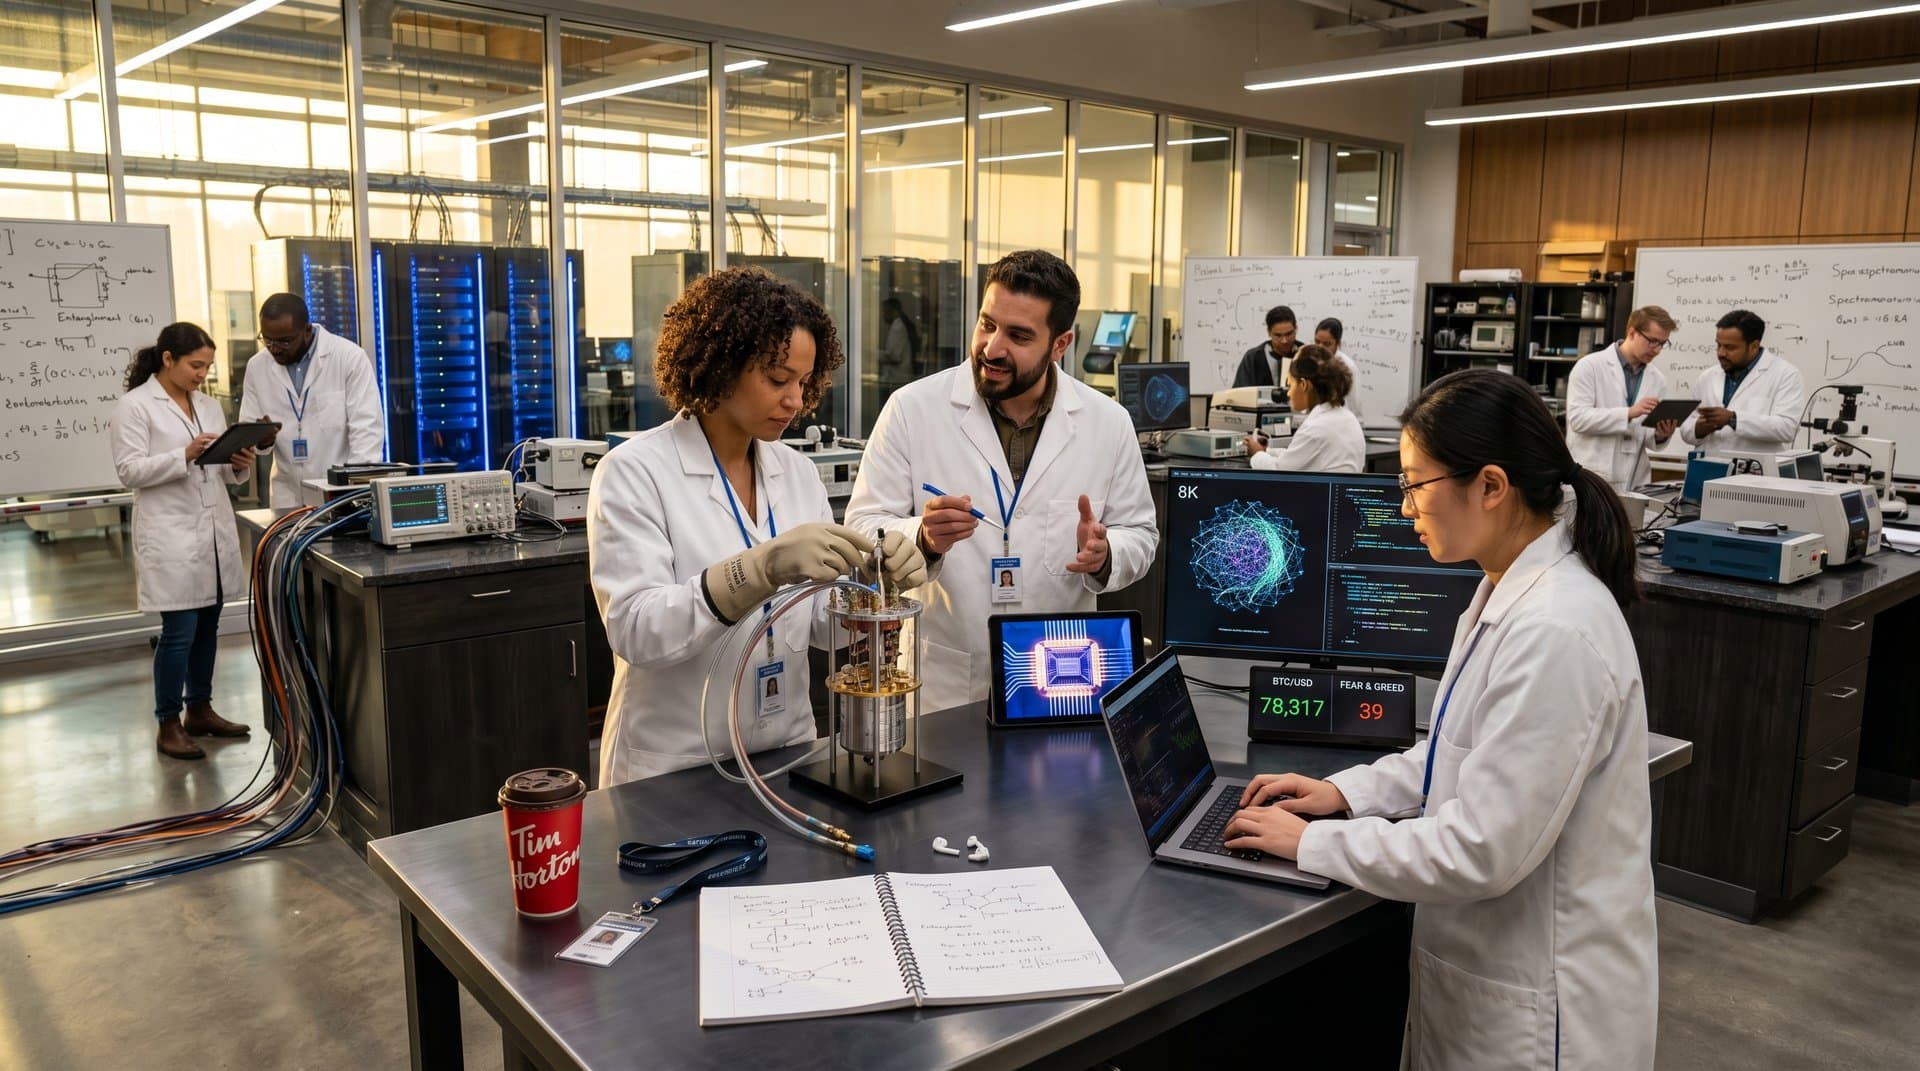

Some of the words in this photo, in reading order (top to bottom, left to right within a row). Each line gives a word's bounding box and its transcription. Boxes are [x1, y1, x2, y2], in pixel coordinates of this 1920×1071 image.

[1178, 485, 1199, 499] 8K
[1272, 677, 1313, 687] BTC/USD
[1340, 680, 1364, 690] FEAR
[1365, 682, 1372, 690] &
[1374, 682, 1405, 692] GREED
[1260, 697, 1325, 717] 78,317
[1359, 702, 1384, 720] 39
[510, 823, 562, 858] Tim
